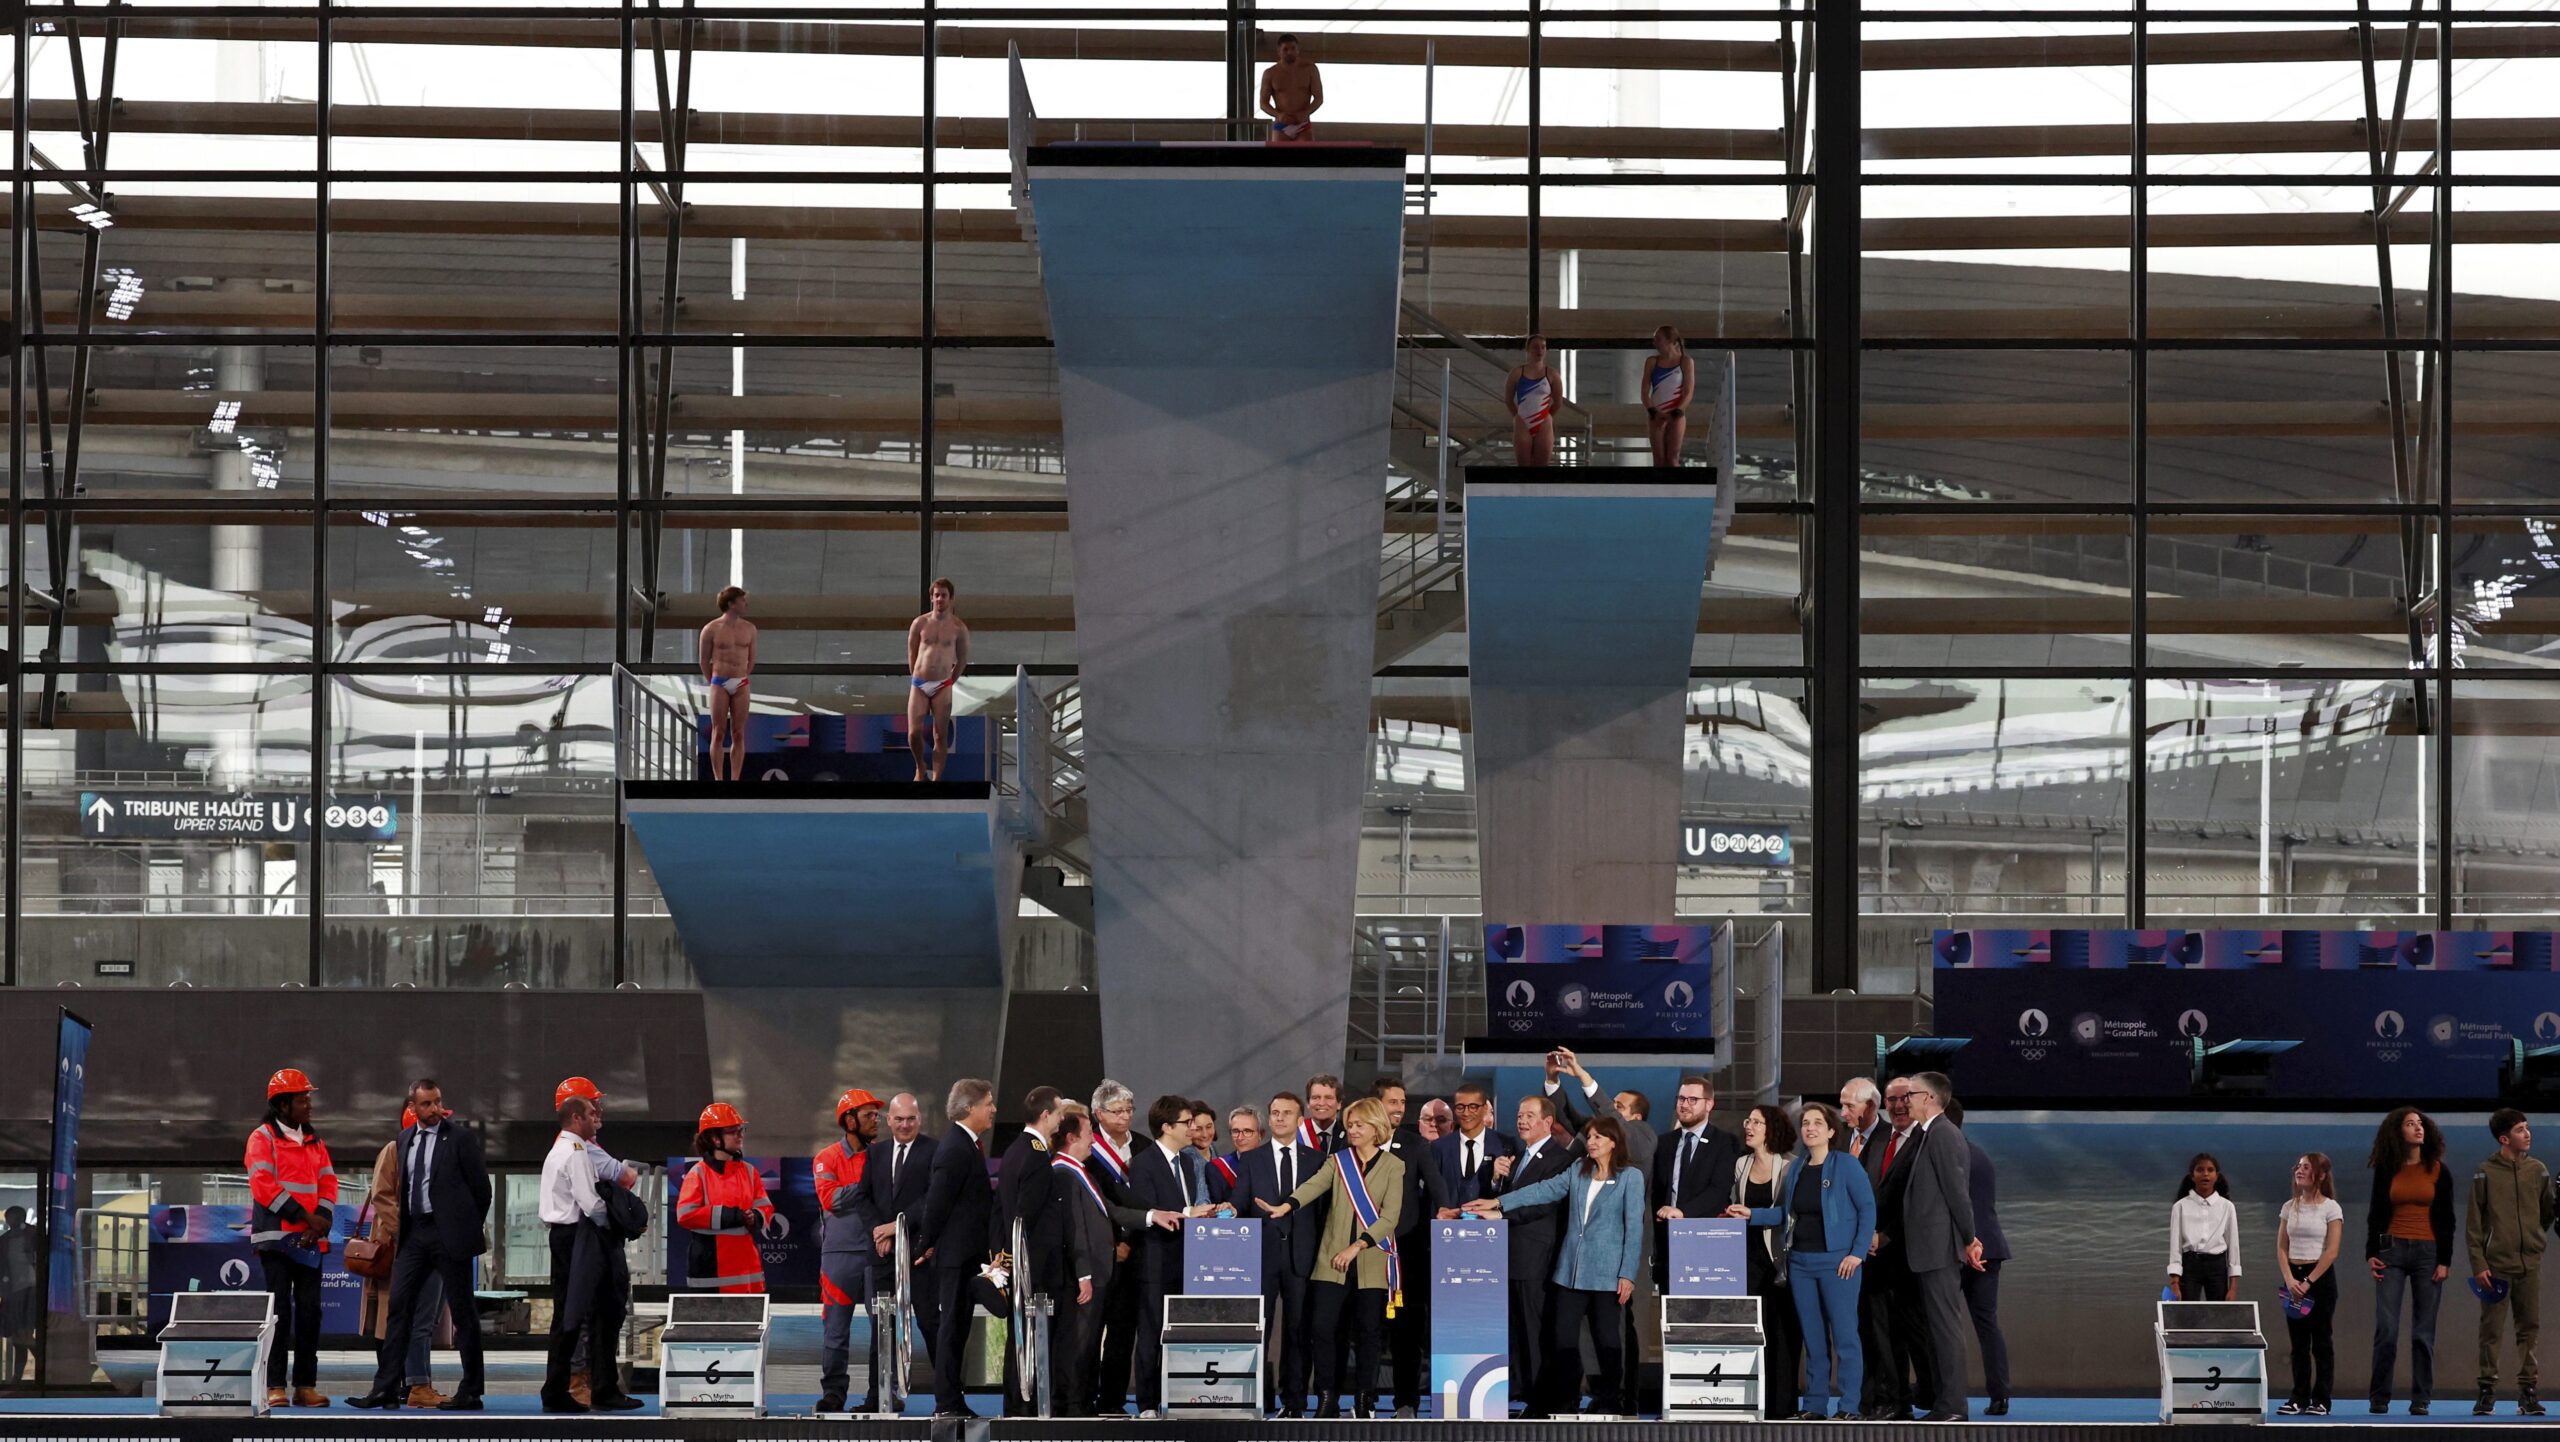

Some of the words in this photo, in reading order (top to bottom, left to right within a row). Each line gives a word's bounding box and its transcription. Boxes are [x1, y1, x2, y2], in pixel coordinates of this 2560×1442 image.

[124, 800, 199, 817] TRIBUNE
[205, 801, 263, 817] HAUTE
[272, 802, 295, 832] U
[173, 817, 216, 831] UPPER
[218, 818, 263, 831] STAND
[1685, 828, 1706, 856] U
[1590, 991, 1633, 1002] Métropole
[1598, 1000, 1623, 1008] Grand
[1625, 1000, 1644, 1008] Paris
[2104, 1019, 2147, 1030] Métropole
[2459, 1022, 2502, 1032] Métropole
[2112, 1029, 2137, 1037] Grand
[2139, 1029, 2158, 1037] Paris
[2468, 1031, 2493, 1039] Grand
[320, 1280, 339, 1288] rand
[341, 1280, 361, 1288] Paris
[203, 1359, 221, 1383] 7
[705, 1360, 721, 1384] 6
[1203, 1361, 1219, 1385] 5
[1704, 1363, 1722, 1387] 4
[2204, 1366, 2221, 1391] 3
